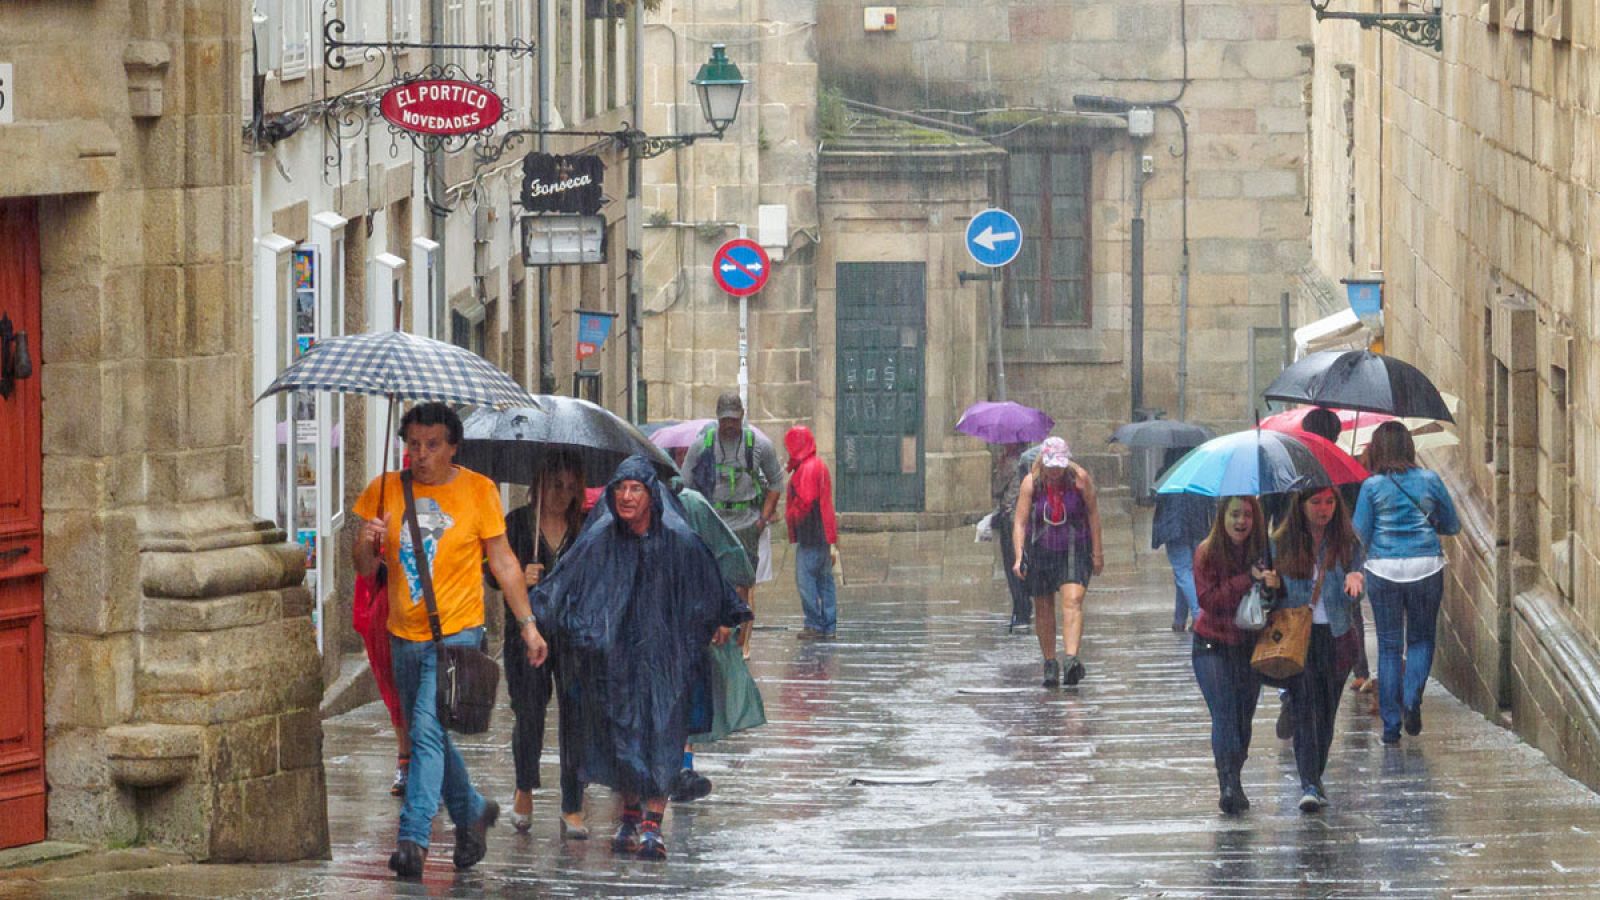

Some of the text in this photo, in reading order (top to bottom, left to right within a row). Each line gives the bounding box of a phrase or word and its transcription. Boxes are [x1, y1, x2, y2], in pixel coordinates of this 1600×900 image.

[396, 85, 488, 109] EL PORTICO
[403, 110, 480, 129] NOVEDADES
[531, 173, 592, 197] Fonseca
